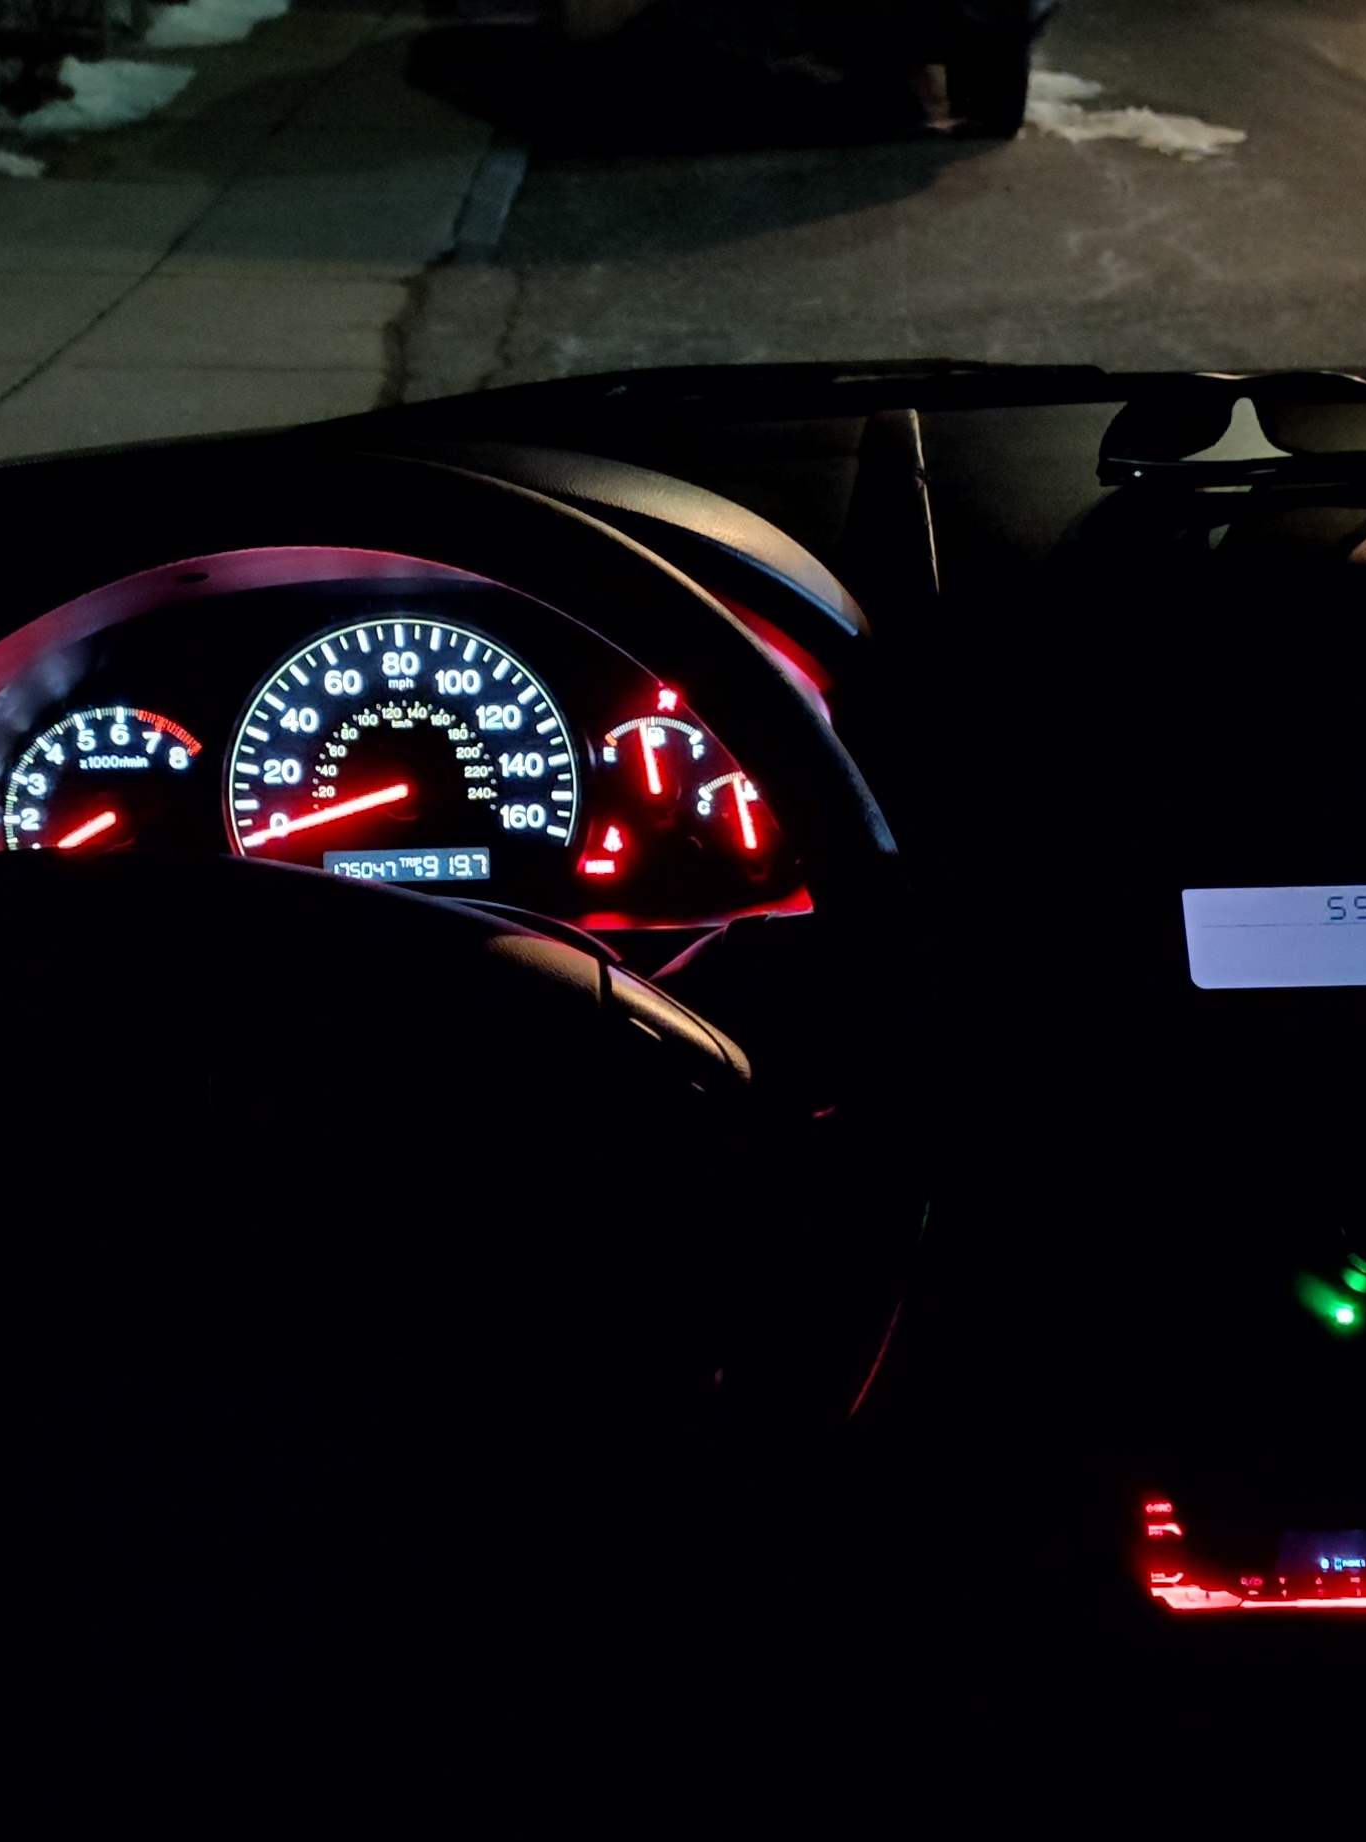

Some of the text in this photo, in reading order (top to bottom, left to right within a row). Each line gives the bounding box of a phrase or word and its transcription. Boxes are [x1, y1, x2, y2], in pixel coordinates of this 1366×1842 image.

[388, 678, 414, 690] mph
[391, 719, 413, 728] km/h
[263, 652, 545, 836] 0 20 40 60 80 100 120 140 160
[318, 707, 491, 799] 20 40 60 80 100 120 140 160 180 200 220 240
[603, 745, 705, 762] E F
[21, 724, 188, 830] 2 3 4 5 6 7 8
[399, 856, 422, 868] TRIP
